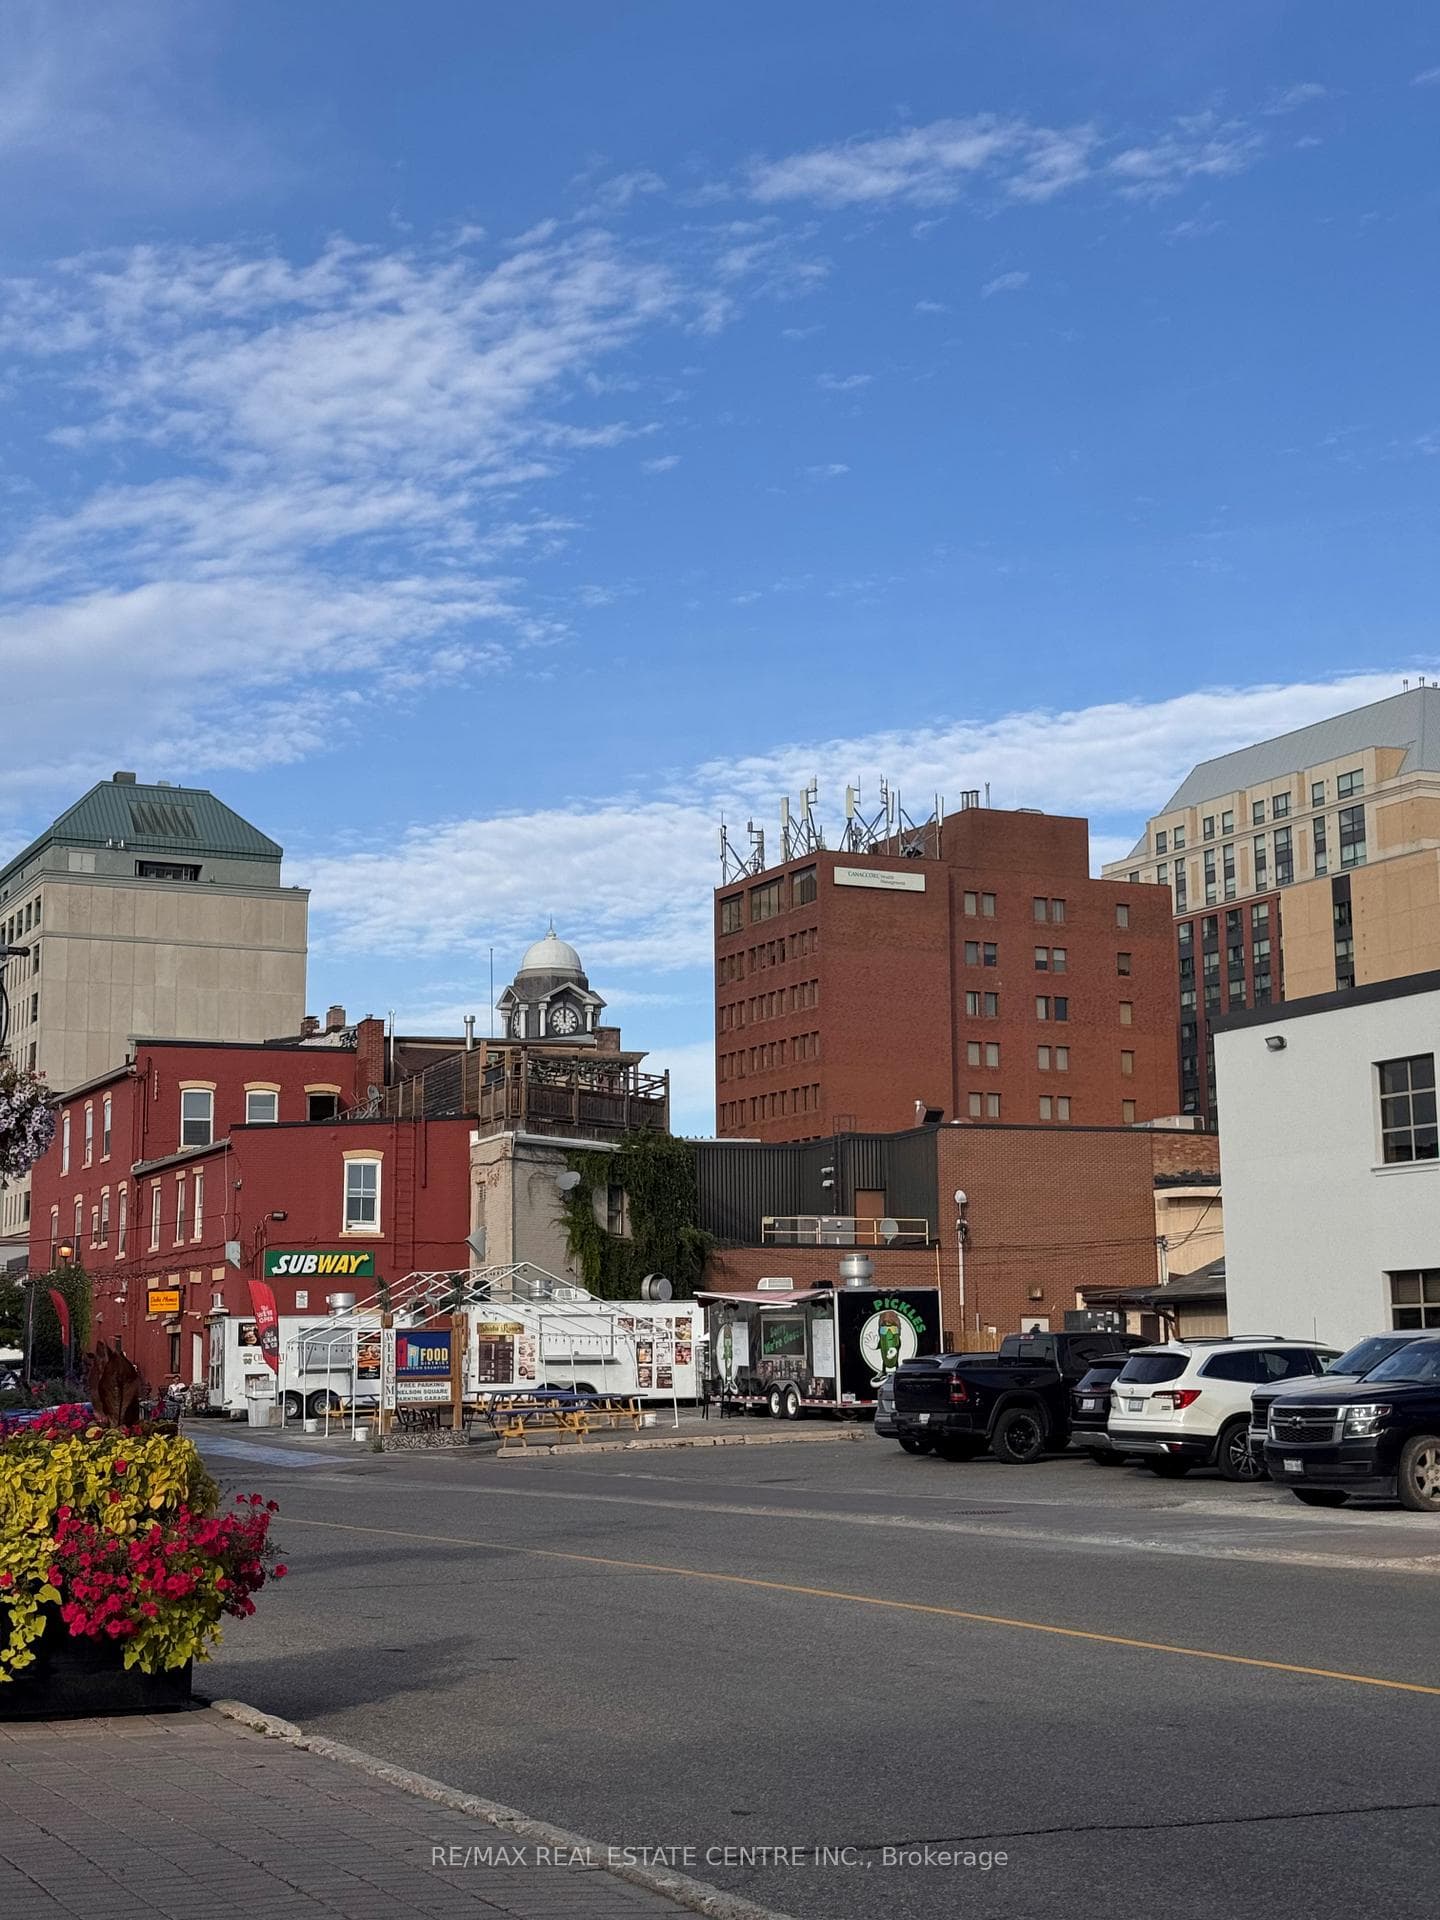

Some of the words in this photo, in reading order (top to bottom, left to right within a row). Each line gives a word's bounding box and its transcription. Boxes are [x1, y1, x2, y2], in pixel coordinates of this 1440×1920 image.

[271, 1253, 370, 1274] SUBWAY
[873, 1298, 926, 1333] PICKLES
[420, 1348, 449, 1361] FOOD
[386, 1332, 395, 1407] WELCOME
